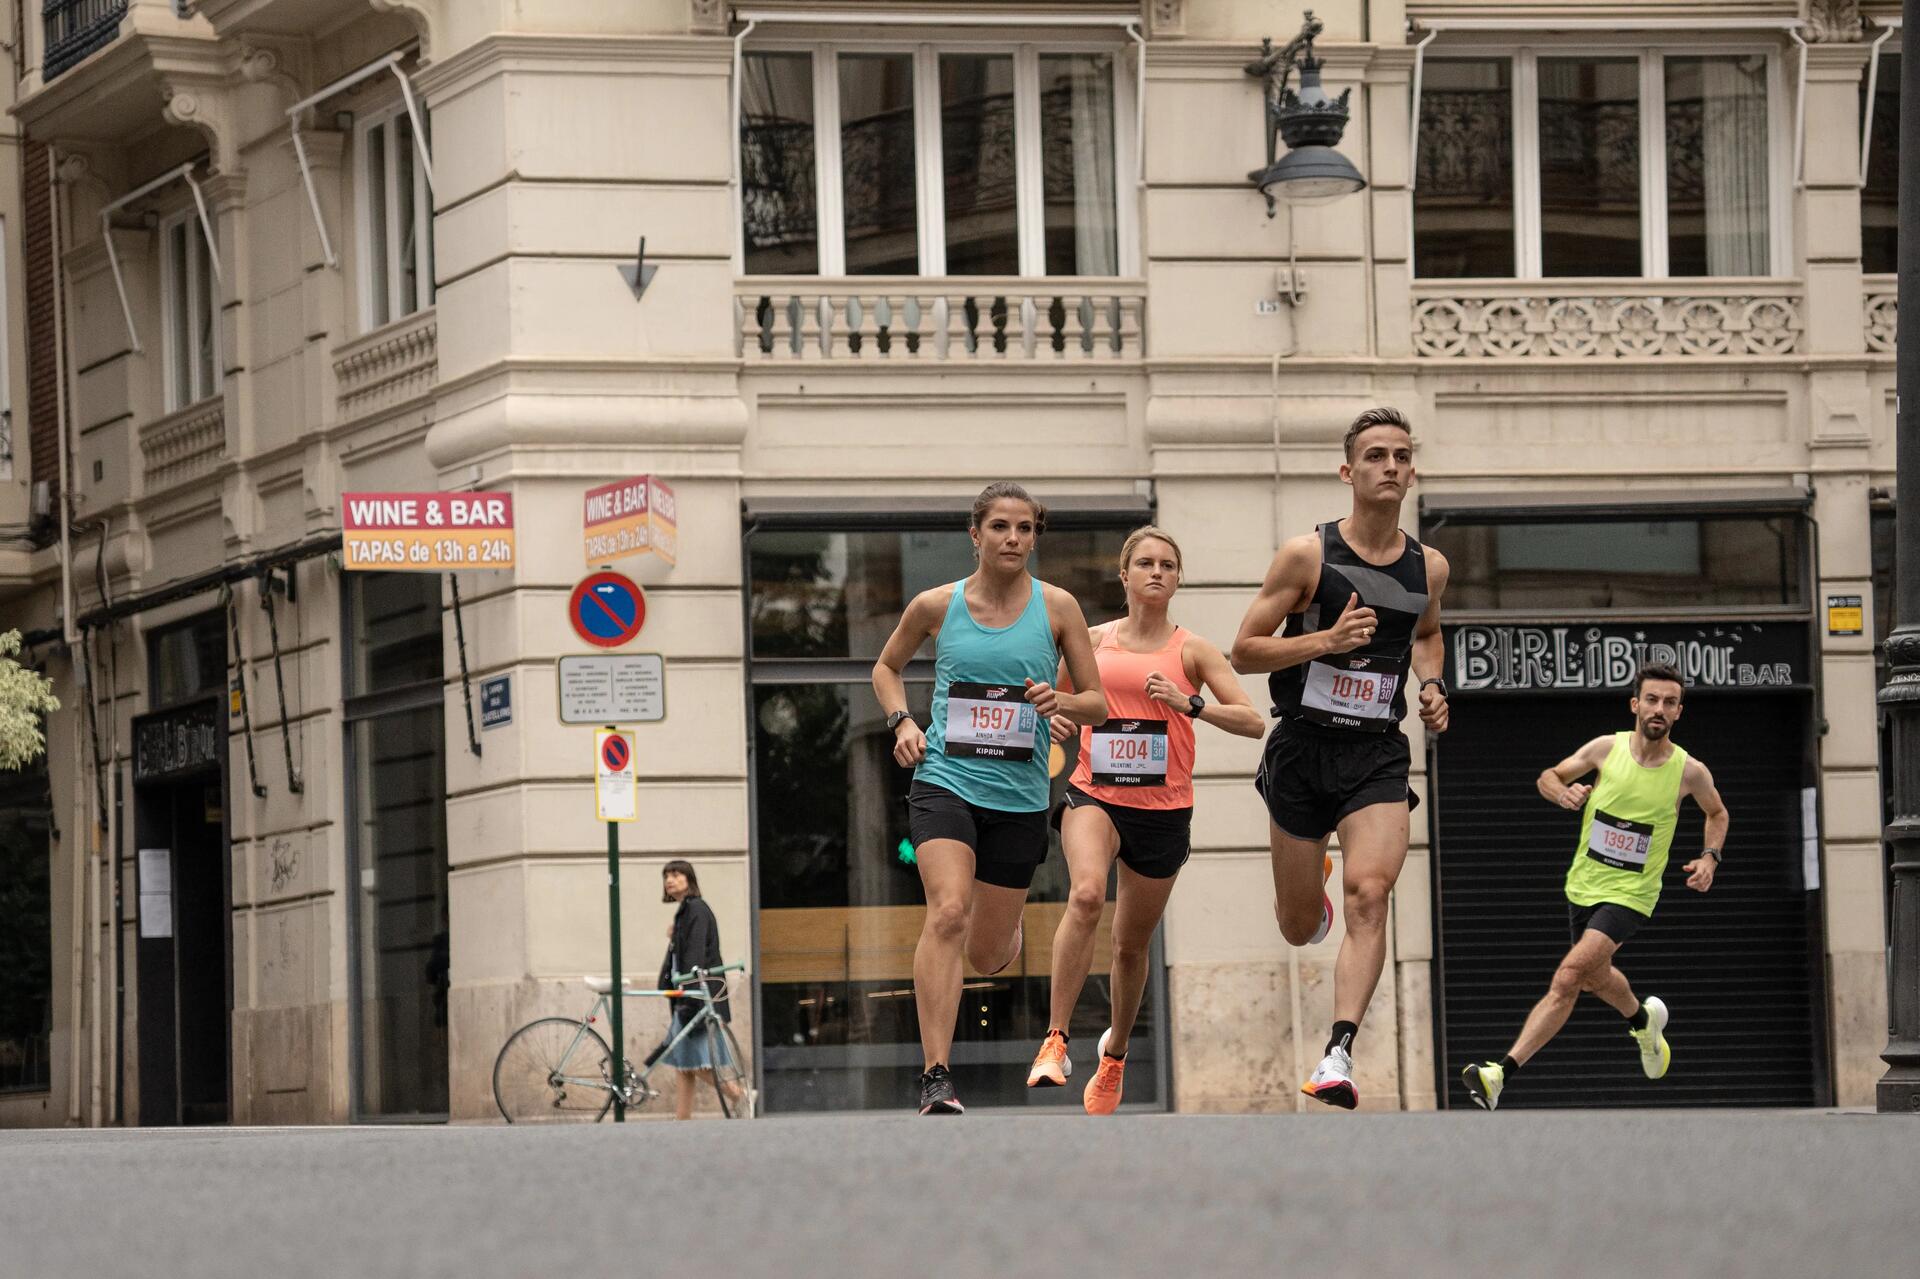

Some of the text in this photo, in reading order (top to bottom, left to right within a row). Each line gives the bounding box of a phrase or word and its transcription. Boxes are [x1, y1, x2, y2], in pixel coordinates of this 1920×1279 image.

[586, 491, 613, 523] WINE
[613, 489, 622, 516] &
[623, 483, 646, 513] BAR
[349, 500, 506, 526] WINE & BAR
[349, 539, 511, 563] TAPAS de 13h a 24h
[1738, 663, 1793, 686] BAR
[1332, 674, 1375, 701] 1018
[1382, 678, 1393, 688] 2H
[1380, 689, 1391, 700] 30
[1330, 699, 1350, 708] THOMAS
[970, 705, 1015, 730] 1597
[1022, 707, 1033, 717] 2H
[1021, 718, 1032, 729] 45
[1332, 716, 1361, 727] KIPRUN
[1153, 736, 1164, 745] 2H
[976, 747, 1004, 756] KIPRUN
[1108, 739, 1148, 760] 1204
[1153, 747, 1164, 758] 30
[1604, 830, 1634, 851] 1392
